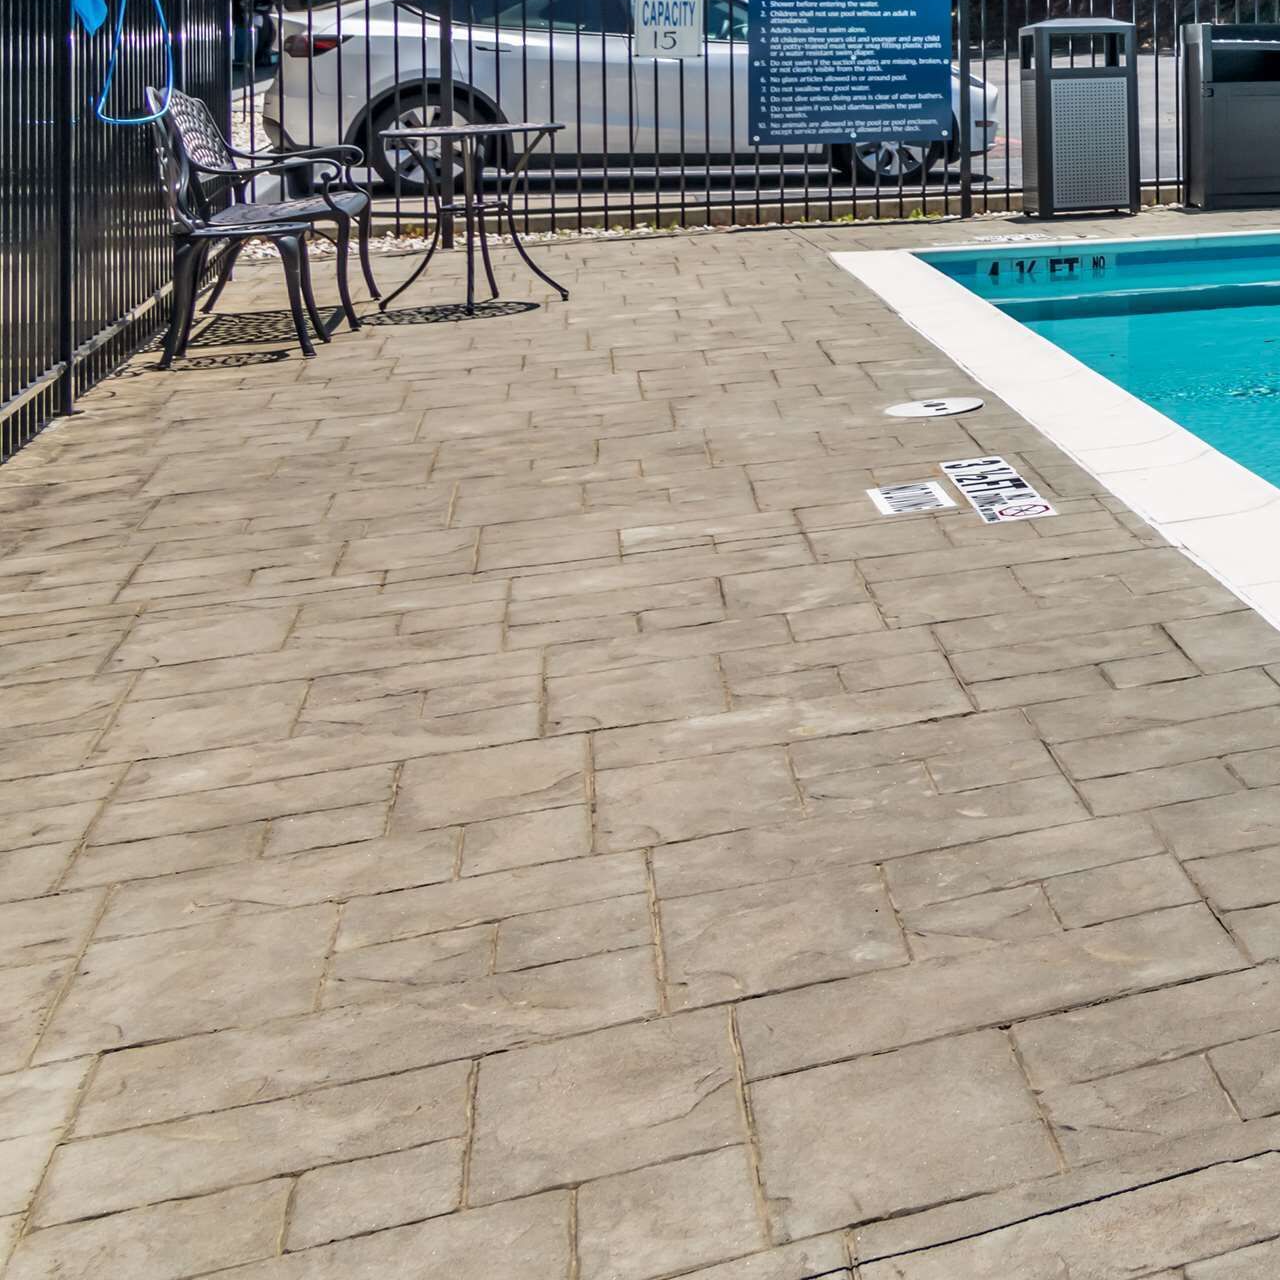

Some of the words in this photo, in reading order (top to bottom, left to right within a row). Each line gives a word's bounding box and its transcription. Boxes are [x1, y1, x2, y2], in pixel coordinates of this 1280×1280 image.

[642, 0, 696, 27] CAPACITY
[654, 31, 677, 50] 15
[1092, 256, 1105, 270] NO
[944, 459, 1001, 469] 3
[961, 477, 1028, 494] FT
